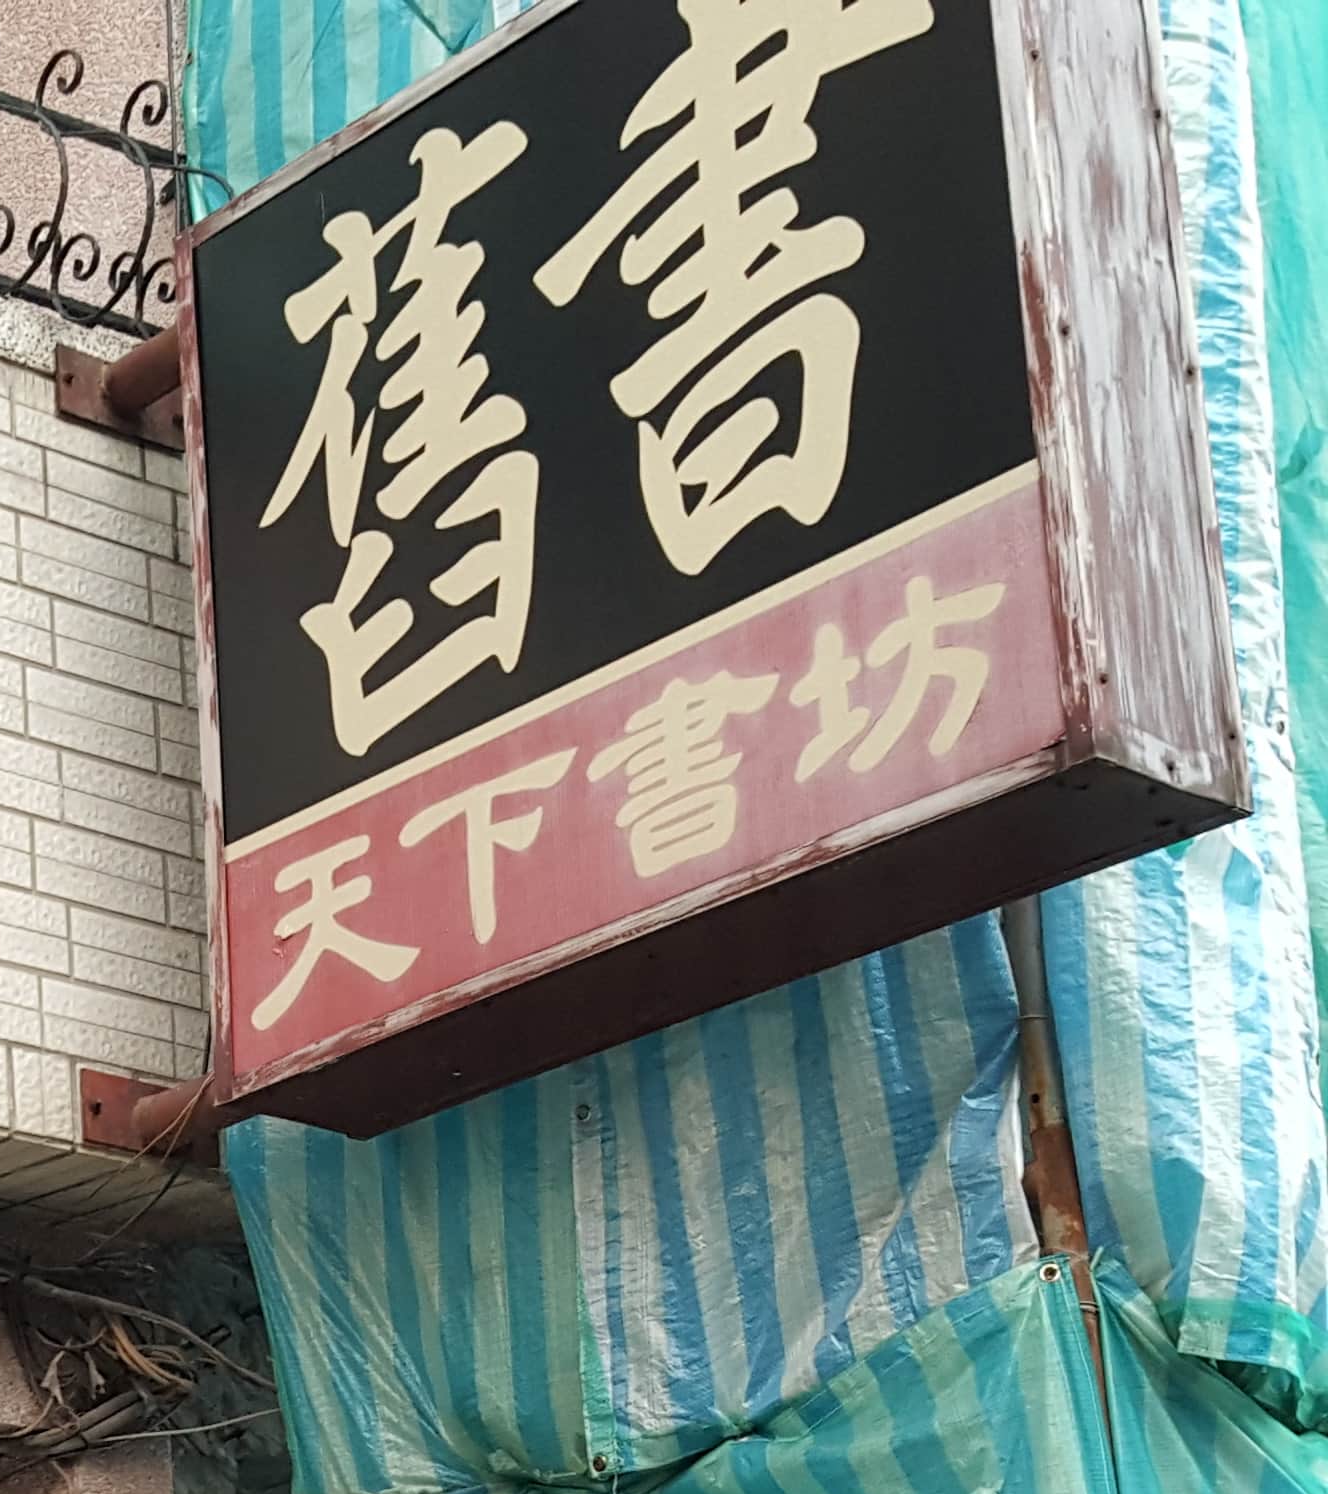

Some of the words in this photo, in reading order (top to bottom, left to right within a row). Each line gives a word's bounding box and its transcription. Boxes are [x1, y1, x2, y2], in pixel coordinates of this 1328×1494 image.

[259, 0, 934, 756] 舊書
[251, 575, 1007, 1031] 天下書坊
